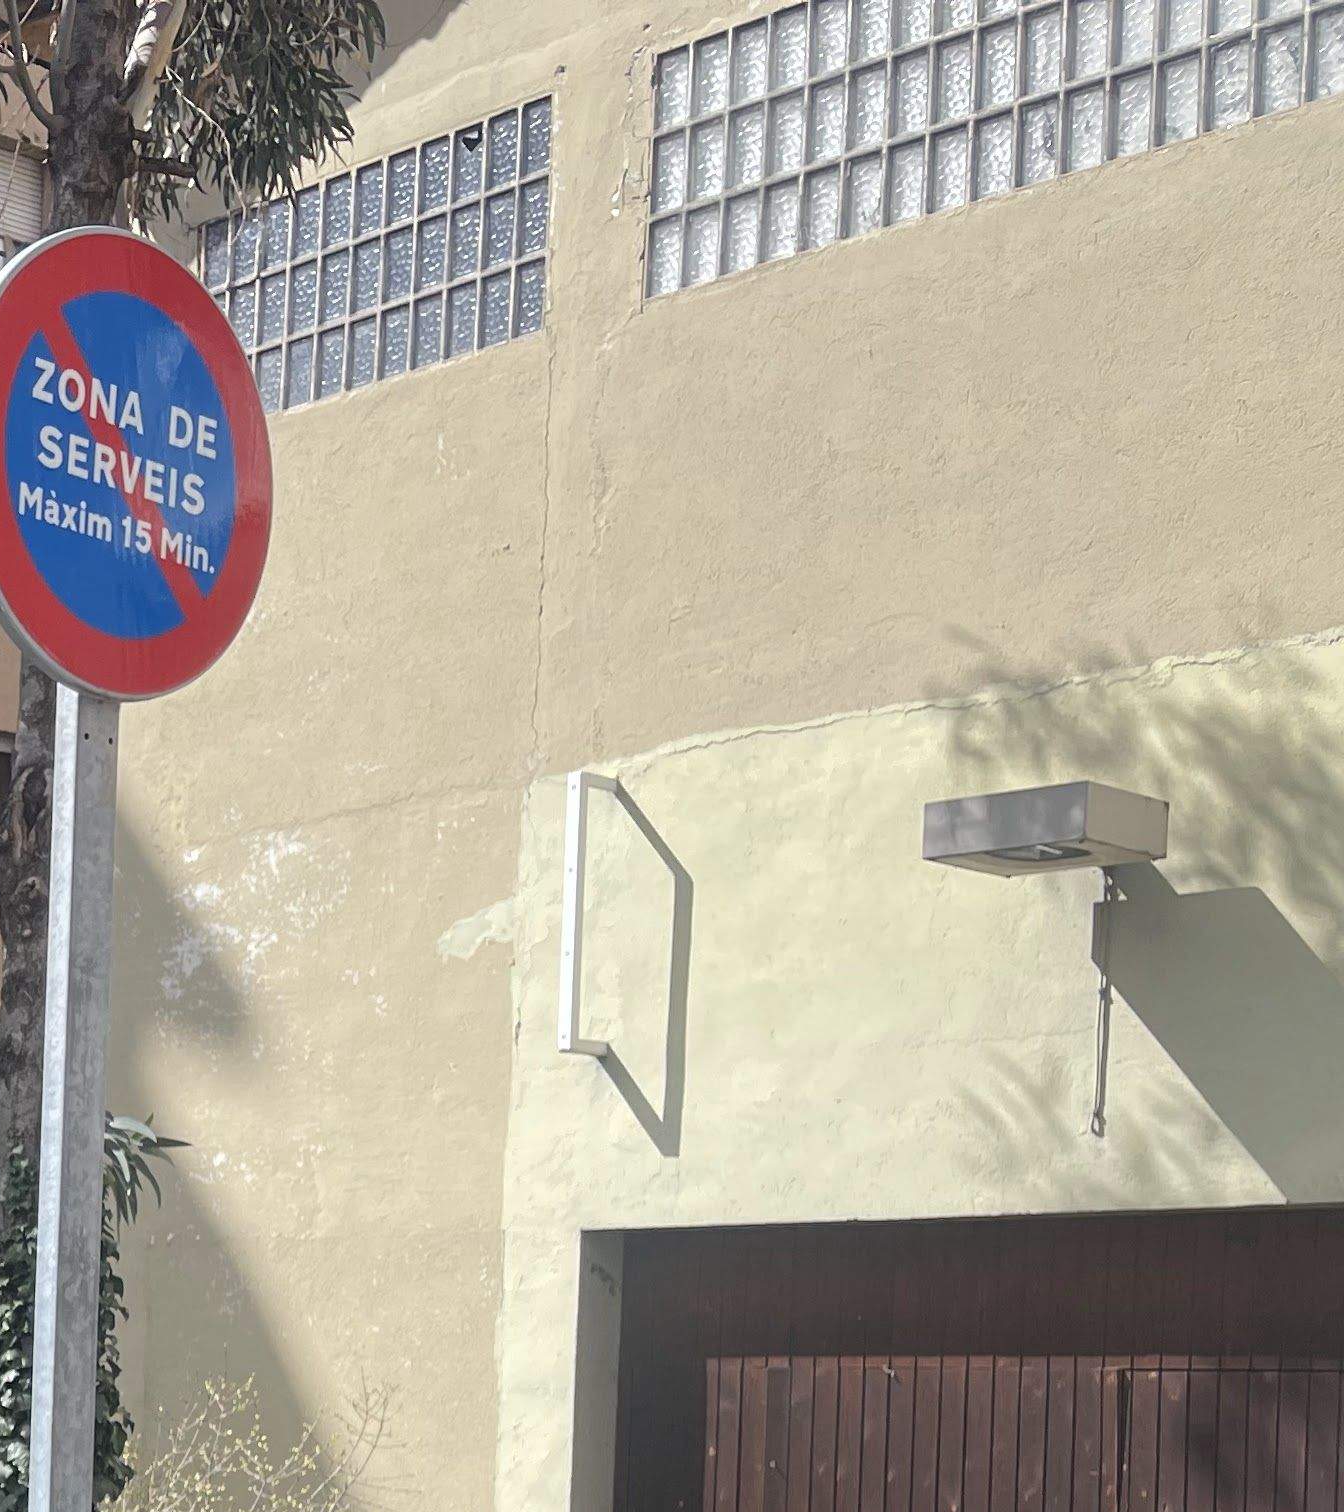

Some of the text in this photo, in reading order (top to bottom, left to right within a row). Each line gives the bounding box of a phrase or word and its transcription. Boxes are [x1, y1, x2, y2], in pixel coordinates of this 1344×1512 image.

[32, 356, 218, 460] ZONA DE
[37, 425, 205, 515] SERVEIS
[18, 481, 215, 575] Màxim 15 Min.
